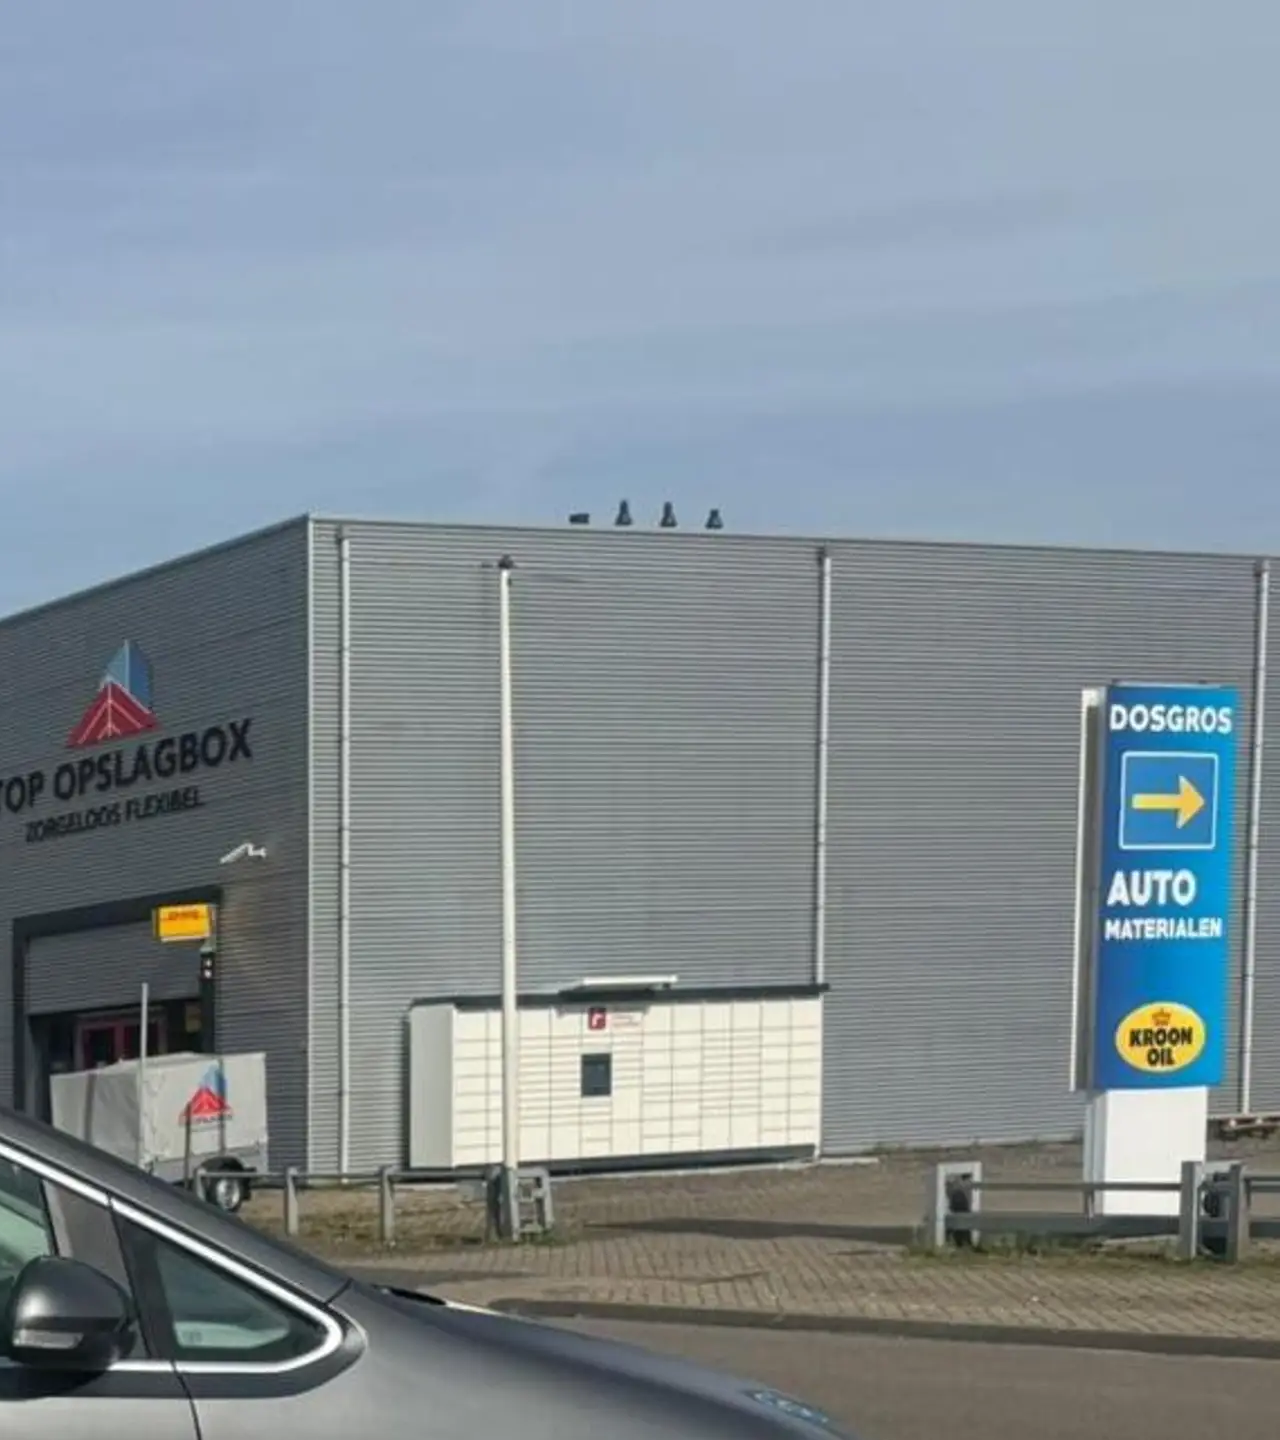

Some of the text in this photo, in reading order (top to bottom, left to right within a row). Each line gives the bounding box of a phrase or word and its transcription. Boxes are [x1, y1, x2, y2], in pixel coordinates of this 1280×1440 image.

[1109, 704, 1232, 734] DOSGROS
[54, 719, 252, 800] OPSLAGBOX
[1106, 869, 1196, 905] AUTO
[1104, 917, 1223, 941] MATERIALEN
[1129, 1026, 1193, 1046] KROON
[1147, 1047, 1175, 1066] OIL
